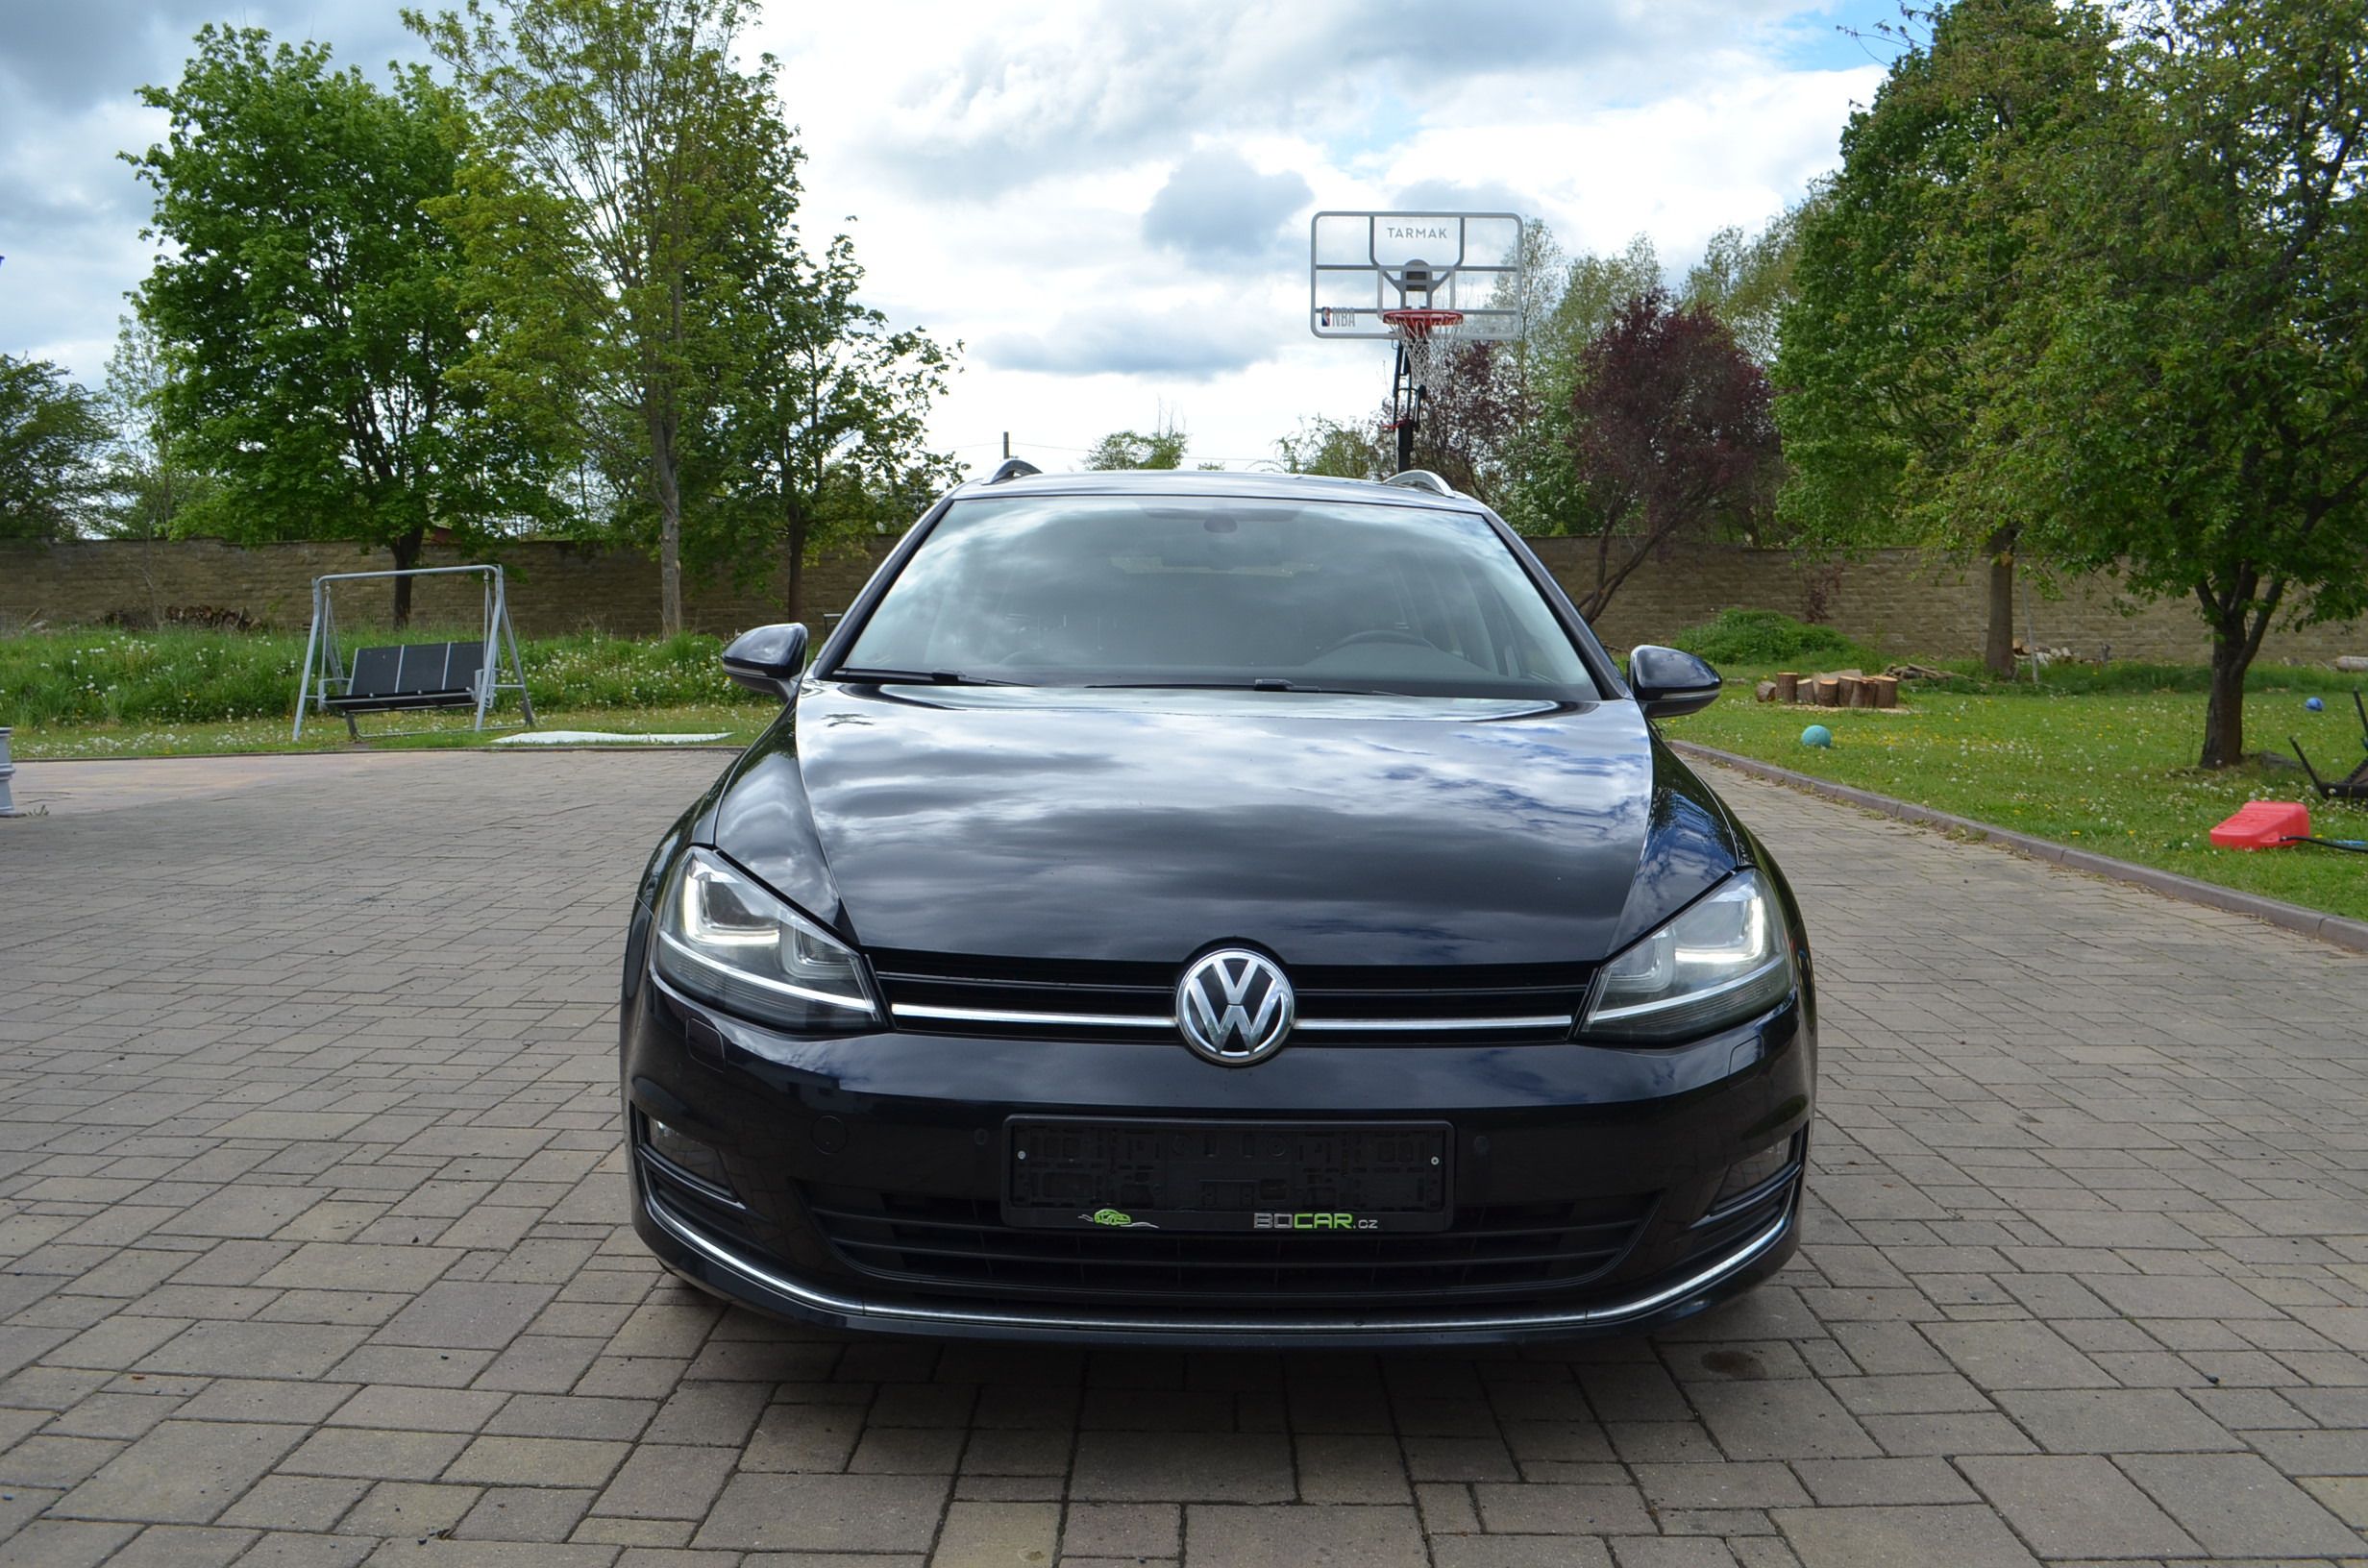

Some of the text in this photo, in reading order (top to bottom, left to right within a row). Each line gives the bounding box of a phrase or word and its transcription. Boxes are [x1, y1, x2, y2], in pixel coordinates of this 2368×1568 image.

[1387, 227, 1447, 239] TARMAK
[1332, 307, 1355, 327] NBA
[1184, 956, 1286, 1059] VW
